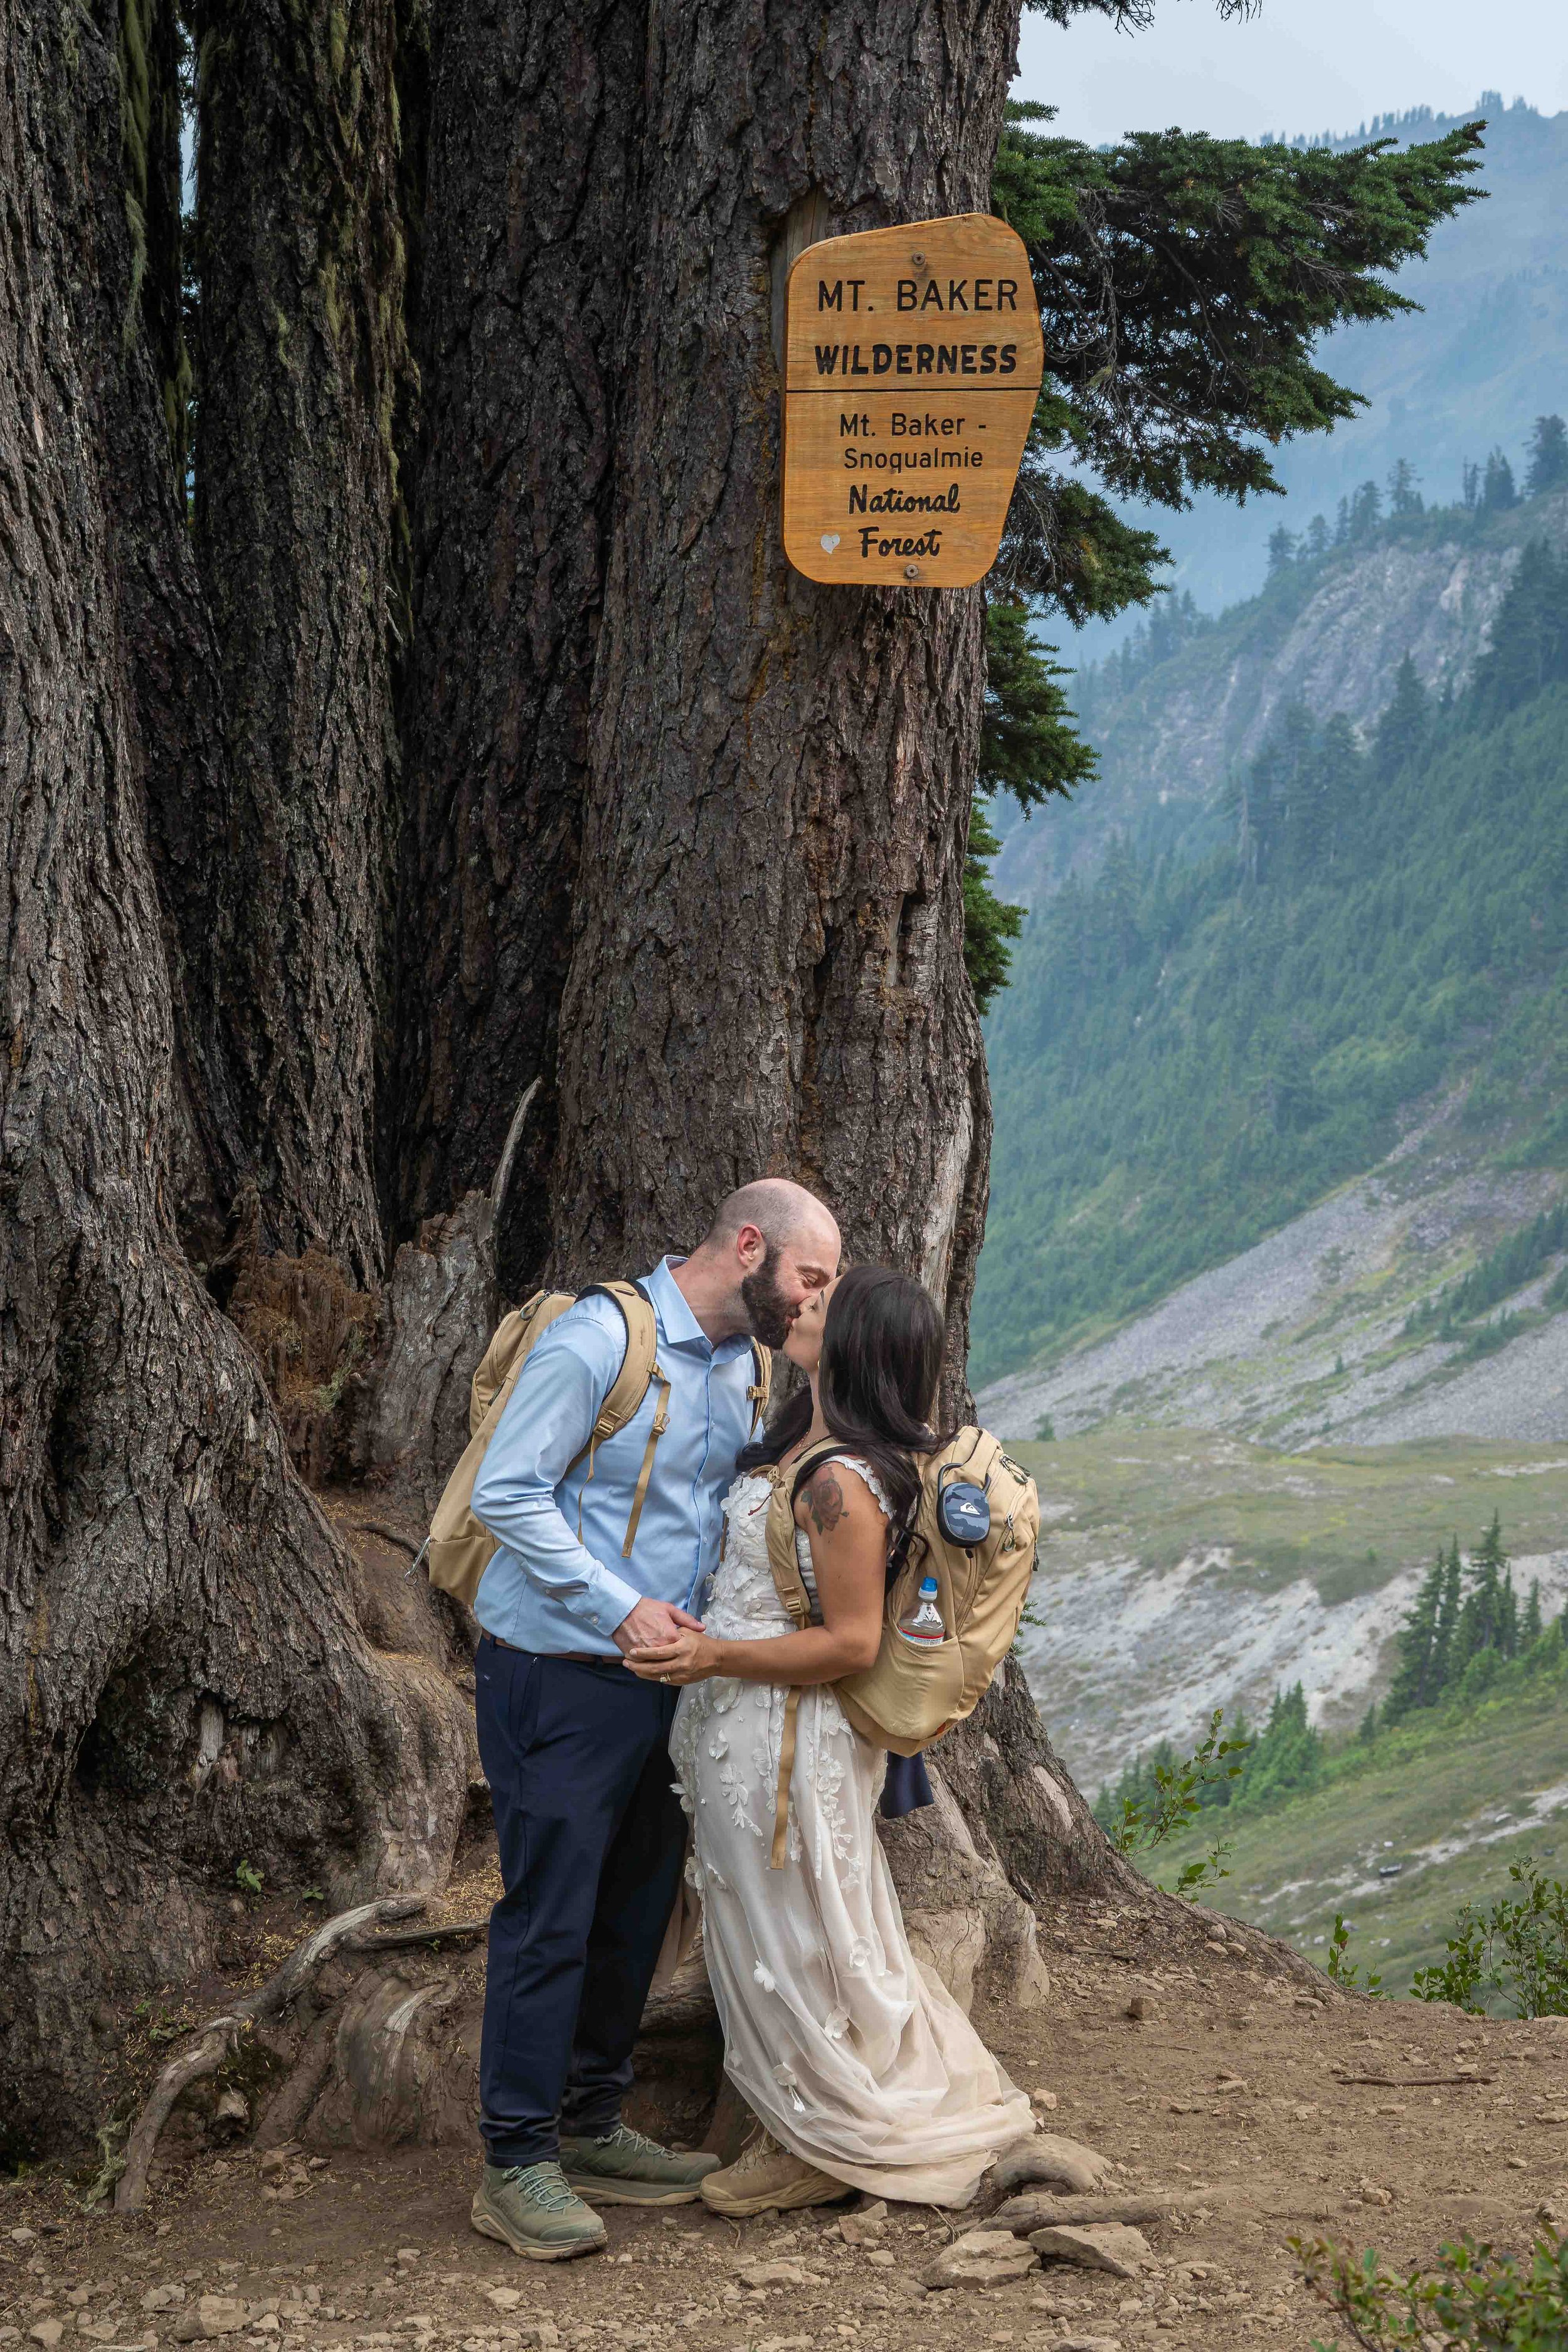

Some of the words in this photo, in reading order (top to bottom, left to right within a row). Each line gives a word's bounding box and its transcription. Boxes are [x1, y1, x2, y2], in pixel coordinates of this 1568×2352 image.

[818, 280, 874, 312] MT.
[897, 279, 1018, 311] BAKER
[814, 344, 1017, 374] WILDERNESS
[840, 413, 876, 437] Mt.
[891, 413, 966, 436] Baker
[844, 447, 983, 474] Snoqualmie
[849, 483, 961, 514] National
[857, 526, 943, 558] Forest
